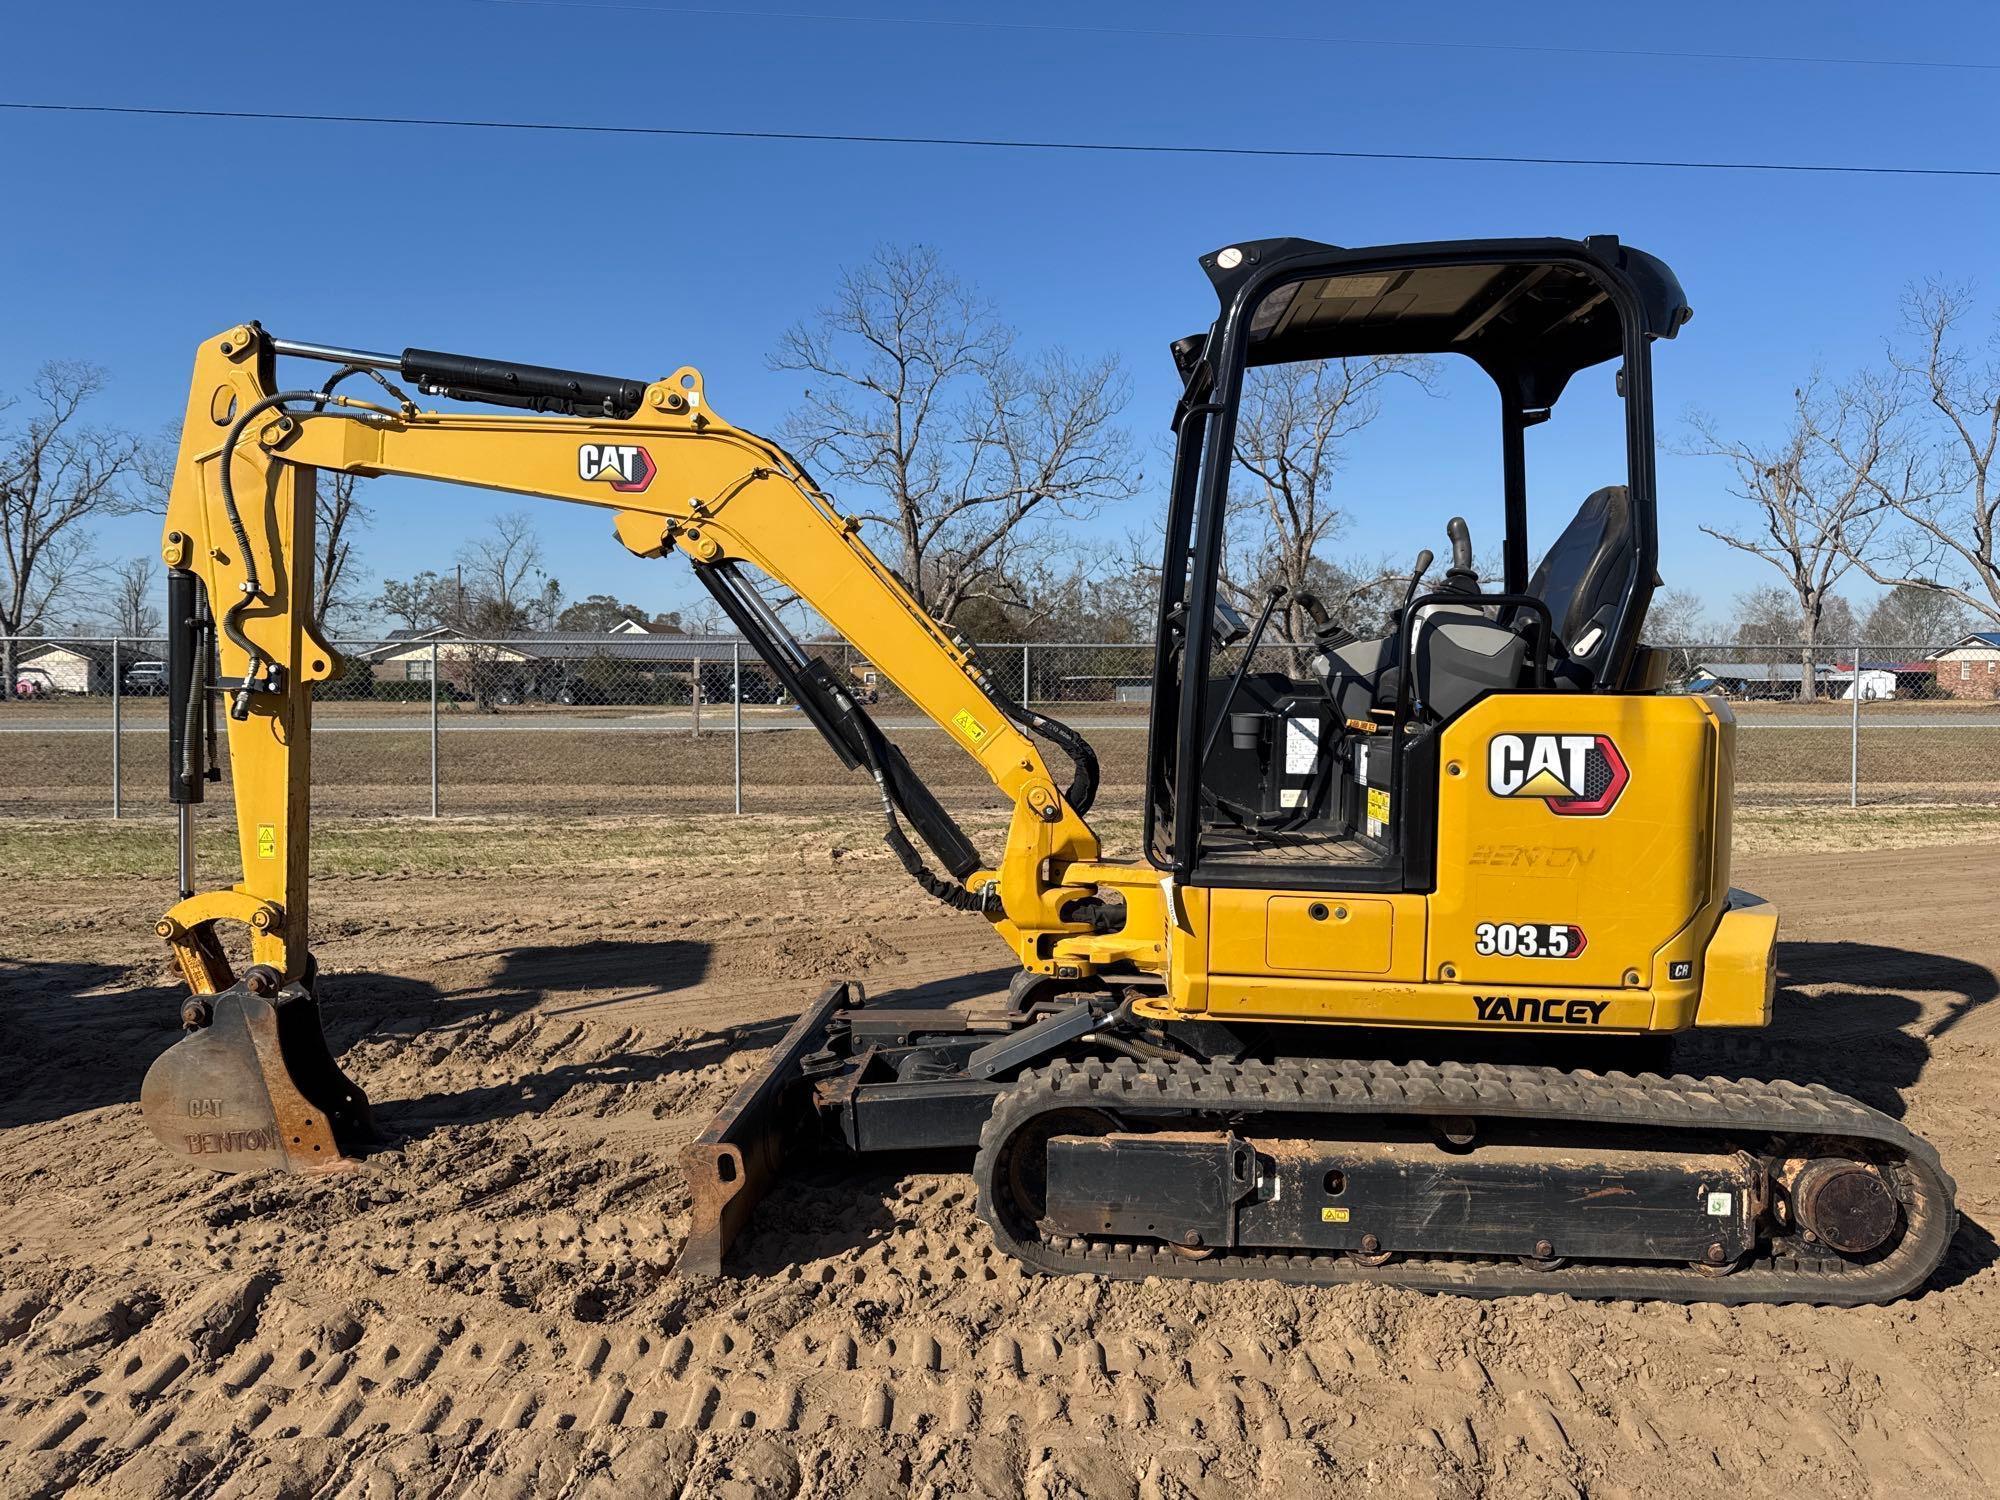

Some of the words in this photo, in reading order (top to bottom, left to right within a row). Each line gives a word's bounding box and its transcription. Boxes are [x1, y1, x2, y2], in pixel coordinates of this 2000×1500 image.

[580, 444, 638, 481] CAT
[1490, 735, 1595, 796] CAT
[1476, 923, 1569, 957] 303.5
[1675, 964, 1689, 977] CR
[1473, 996, 1611, 1024] YANCEY
[189, 1099, 222, 1119] CAT
[184, 1128, 276, 1154] BENTON
